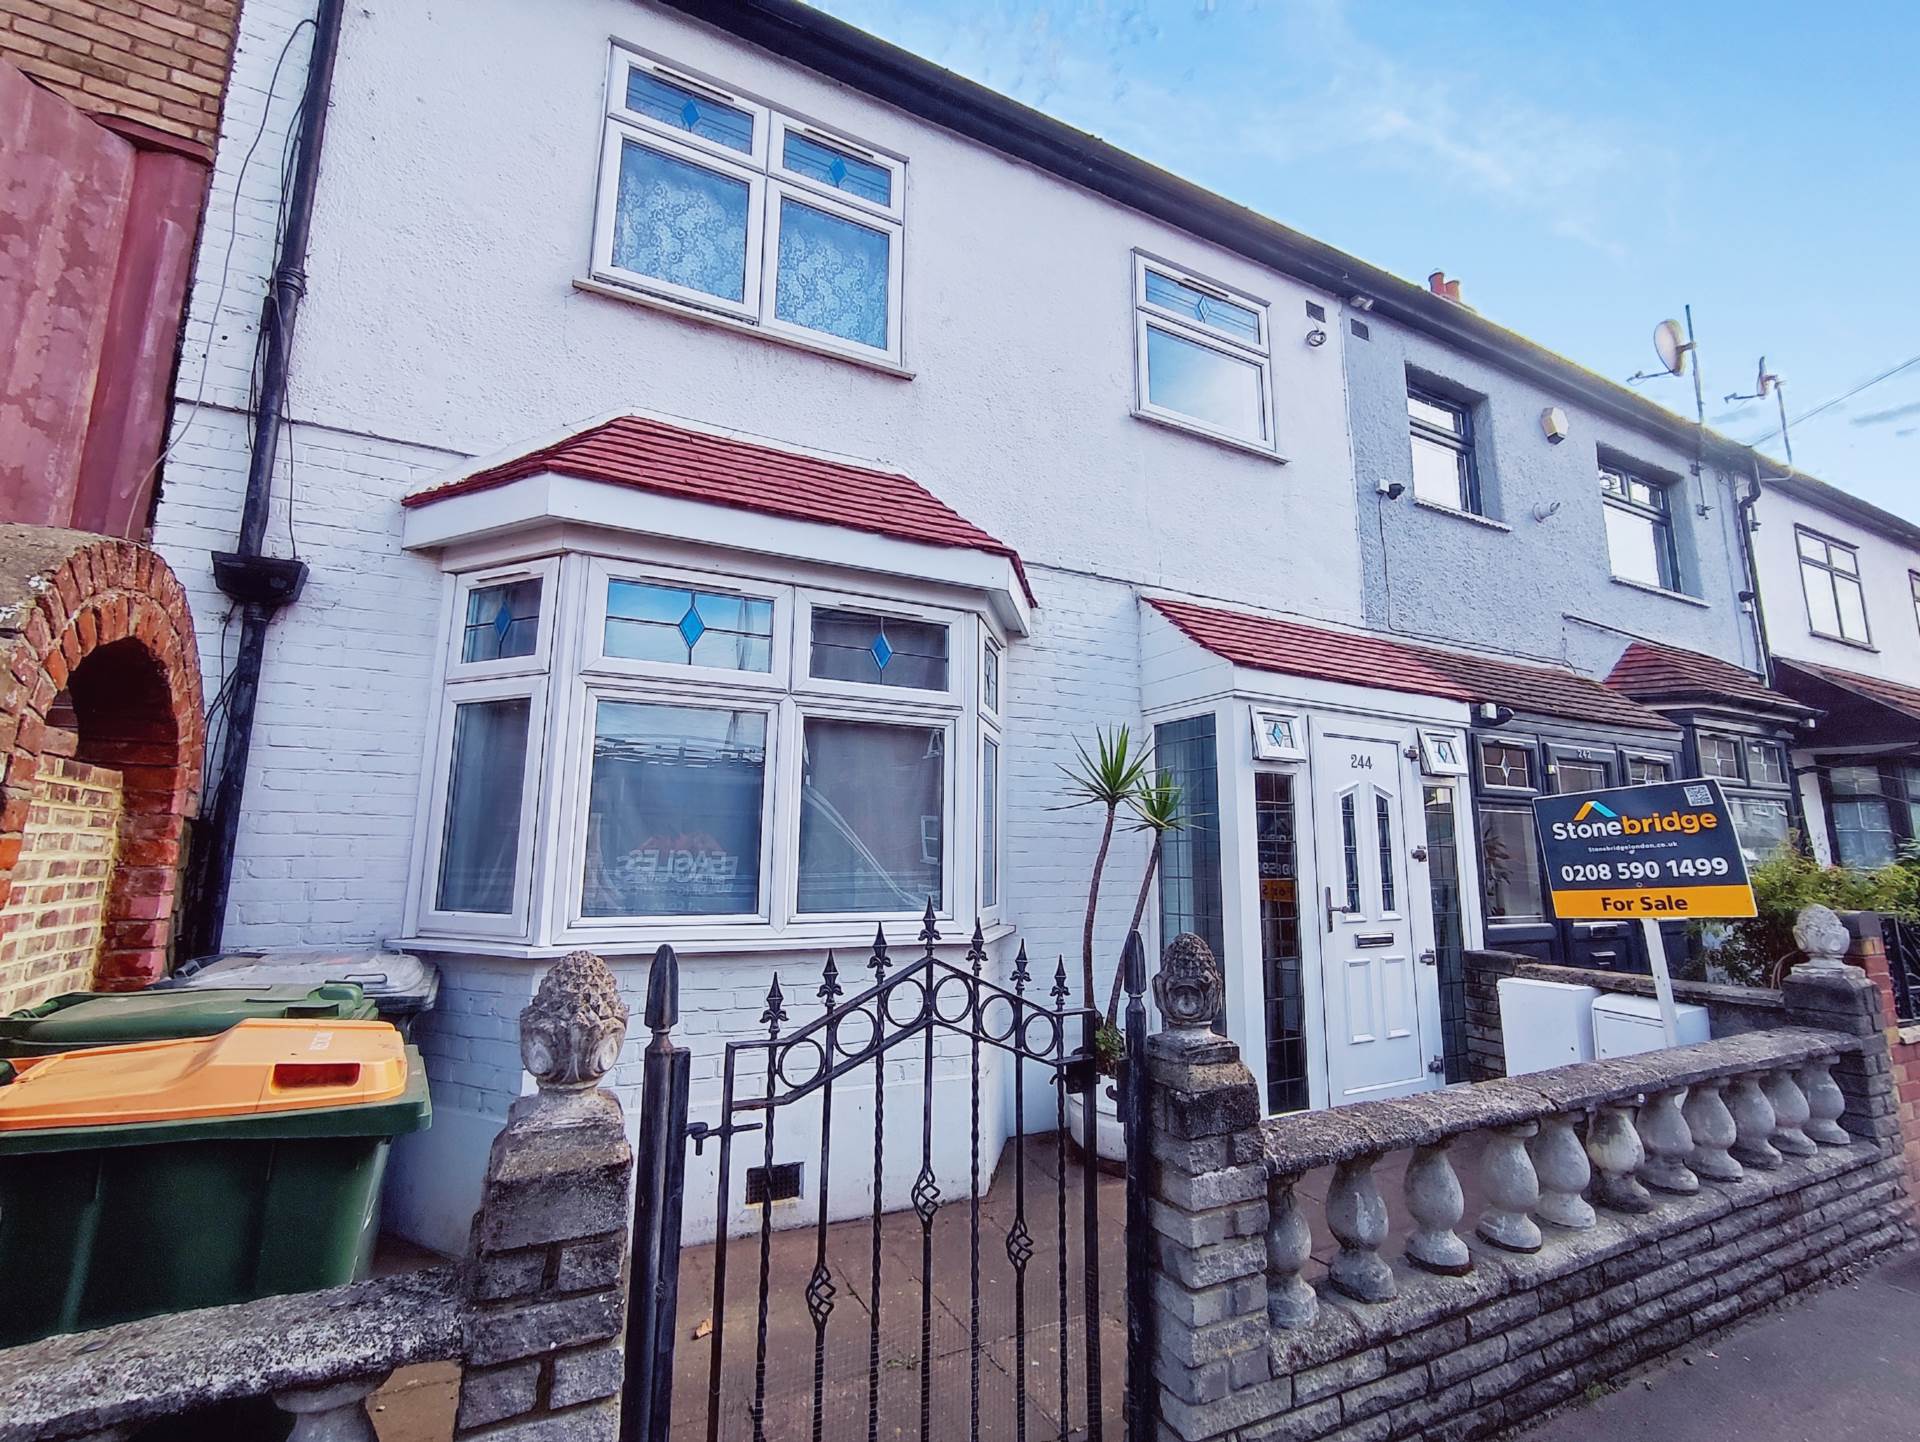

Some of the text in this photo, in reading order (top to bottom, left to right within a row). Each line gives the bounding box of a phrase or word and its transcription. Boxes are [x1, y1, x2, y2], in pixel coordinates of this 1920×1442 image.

[1350, 753, 1373, 770] 244
[1552, 810, 1718, 841] Stonebridge
[1561, 857, 1729, 882] 0208 590 1499
[1601, 895, 1688, 913] For Sale
